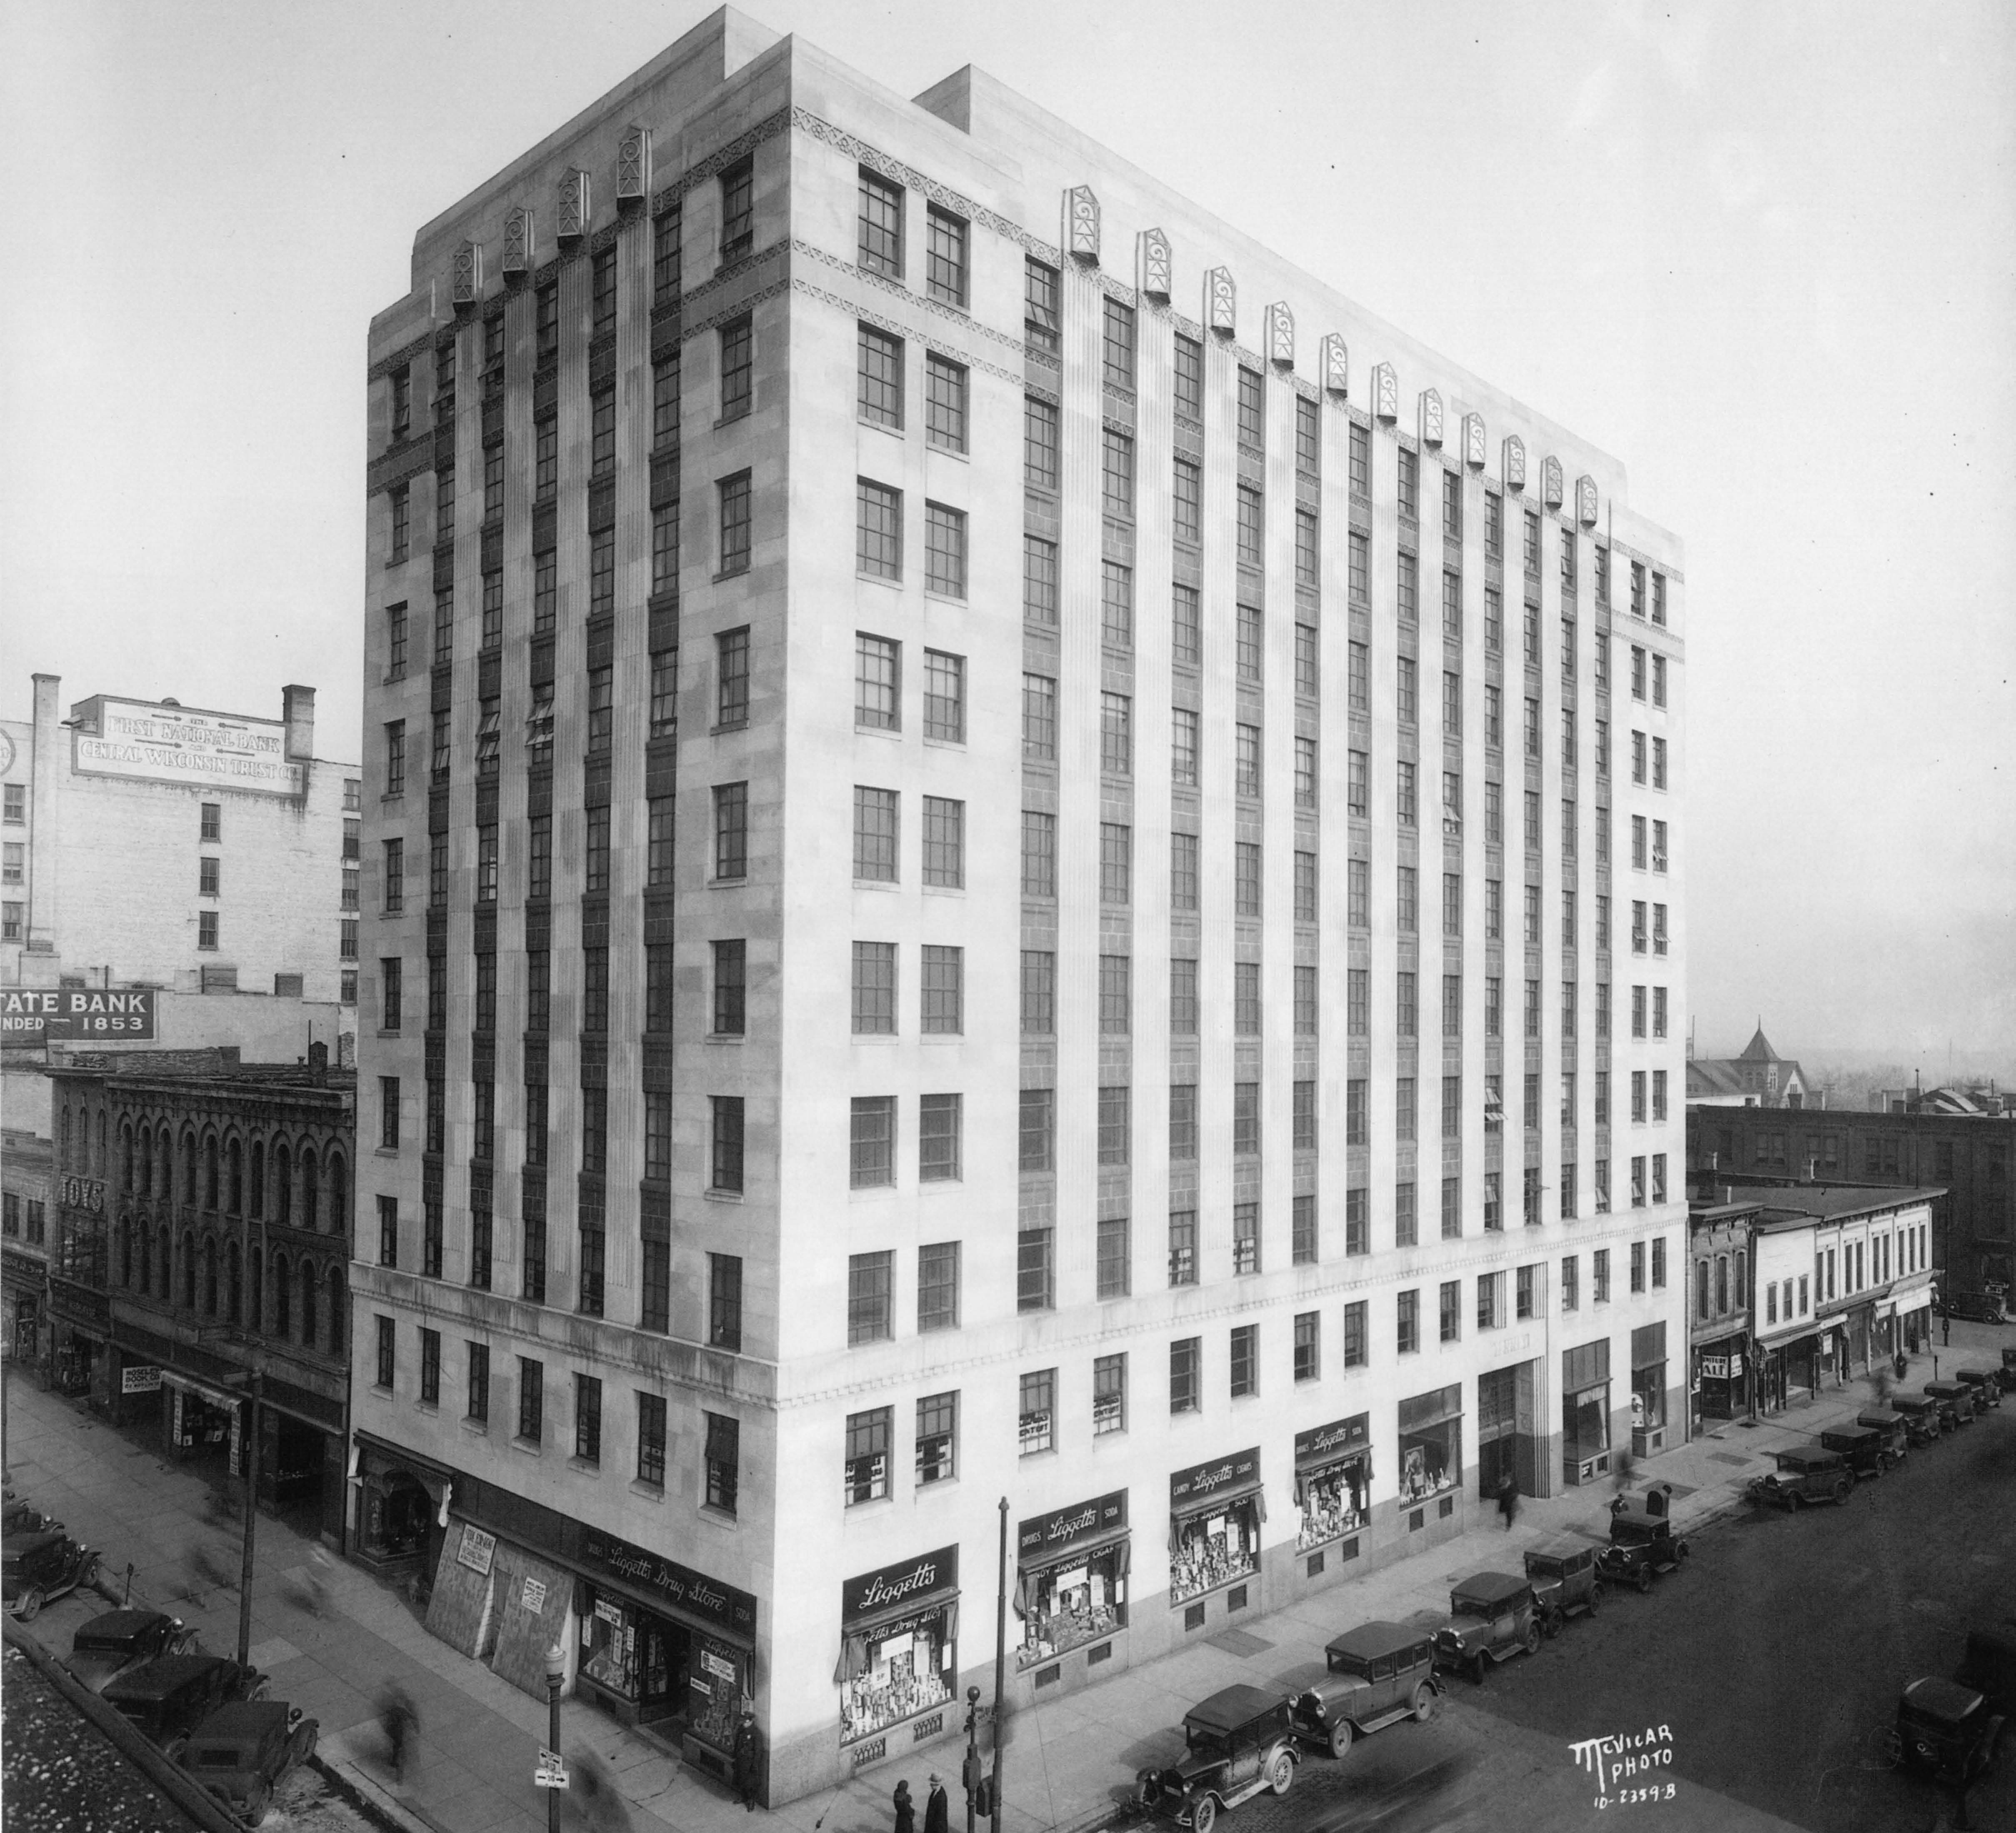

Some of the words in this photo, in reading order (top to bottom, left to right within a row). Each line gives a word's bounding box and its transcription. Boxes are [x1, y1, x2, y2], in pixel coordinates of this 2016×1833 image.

[108, 715, 156, 737] FIRST
[161, 723, 235, 746] NATIONAL
[237, 733, 280, 753] BANK
[81, 741, 143, 763] CENTRAL
[144, 748, 227, 773] WISCONSIN
[230, 759, 277, 779] TRUST
[0, 992, 59, 1012] ATE
[70, 993, 147, 1013] BANK
[0, 1017, 45, 1030] NDED
[83, 1017, 143, 1030] 1853
[60, 1175, 101, 1213] TOYS
[1173, 1482, 1190, 1496] CANDY
[1022, 1531, 1041, 1547] DRUGS
[1104, 1505, 1118, 1519] SODA
[653, 1564, 685, 1601] Drug
[688, 1581, 727, 1612] Store
[892, 1618, 918, 1633] Drug
[920, 1606, 941, 1623] Stor
